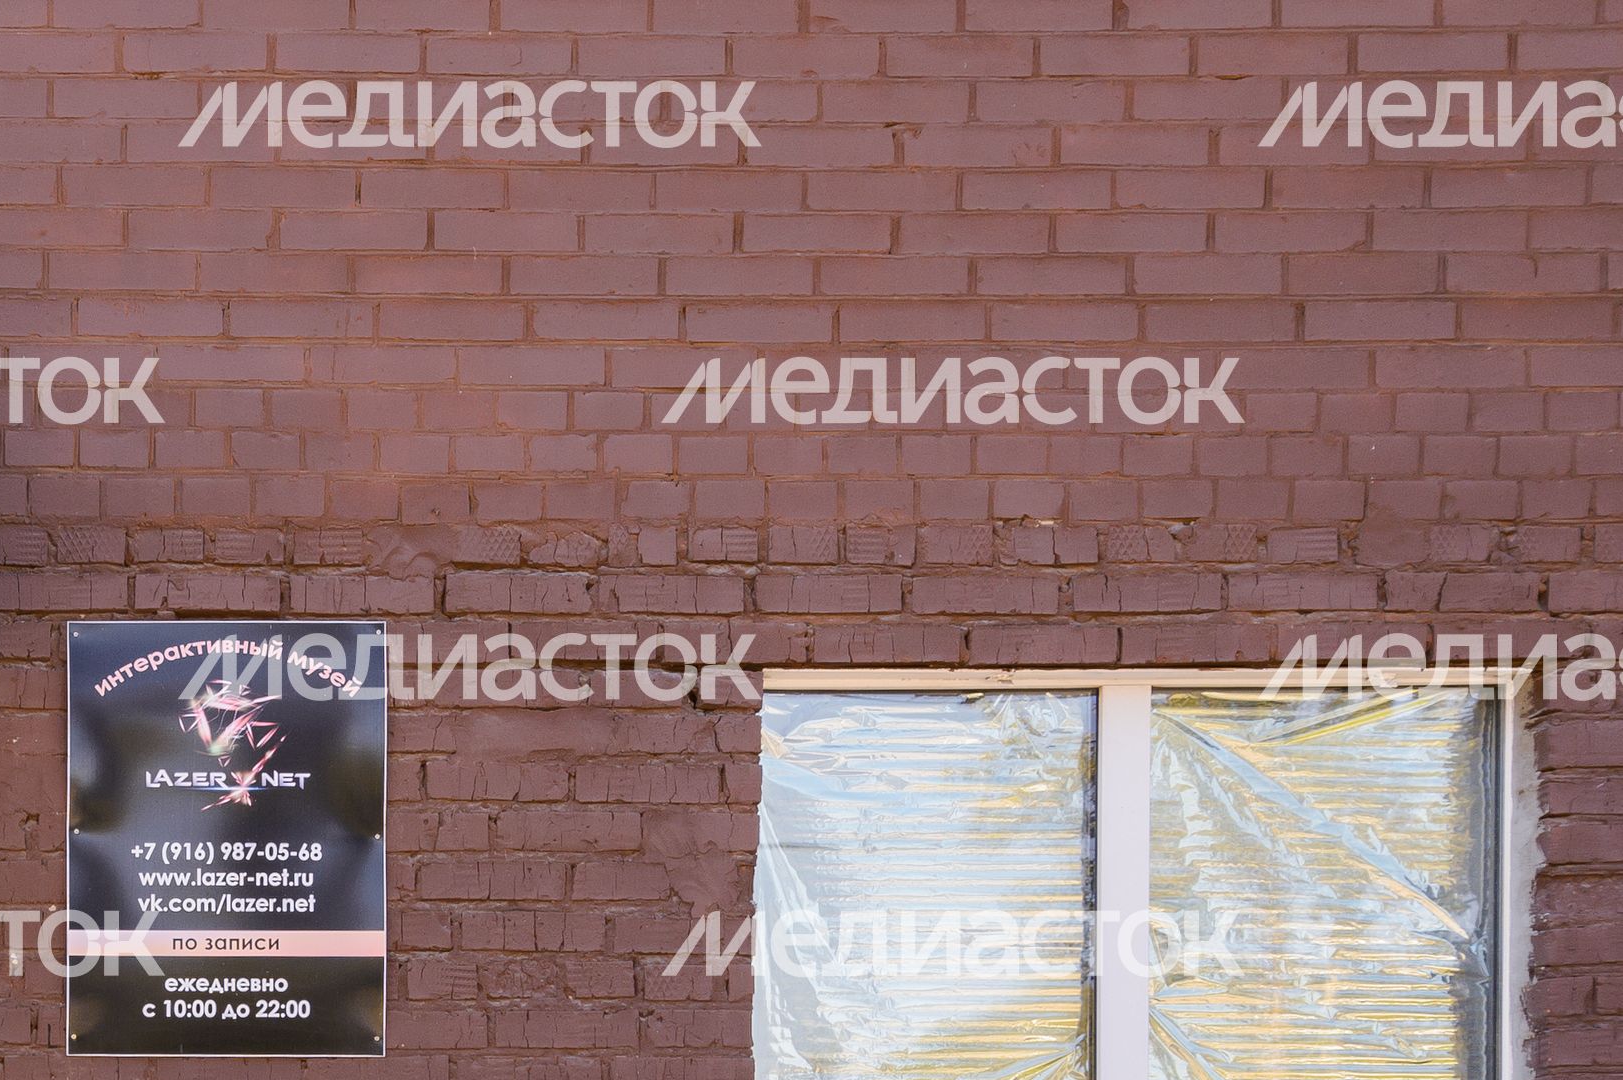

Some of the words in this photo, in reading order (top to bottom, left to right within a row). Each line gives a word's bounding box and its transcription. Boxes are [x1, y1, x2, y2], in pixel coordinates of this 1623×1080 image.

[95, 639, 283, 697] интерактивный
[287, 653, 362, 698] музей
[145, 769, 230, 789] LAZER
[261, 770, 311, 789] NET
[131, 842, 156, 861] +7
[161, 841, 215, 865] (916)
[220, 842, 323, 861] 987-05-68
[138, 868, 314, 887] www.lazer-net.ru
[137, 893, 316, 915] vk.com/lazer.net
[172, 937, 197, 951] по
[204, 937, 280, 951] записи
[164, 977, 289, 994] ежедневно
[142, 1003, 156, 1018] с
[163, 999, 217, 1018] 10:00
[221, 1003, 250, 1020] до
[255, 999, 311, 1018] 22:00
